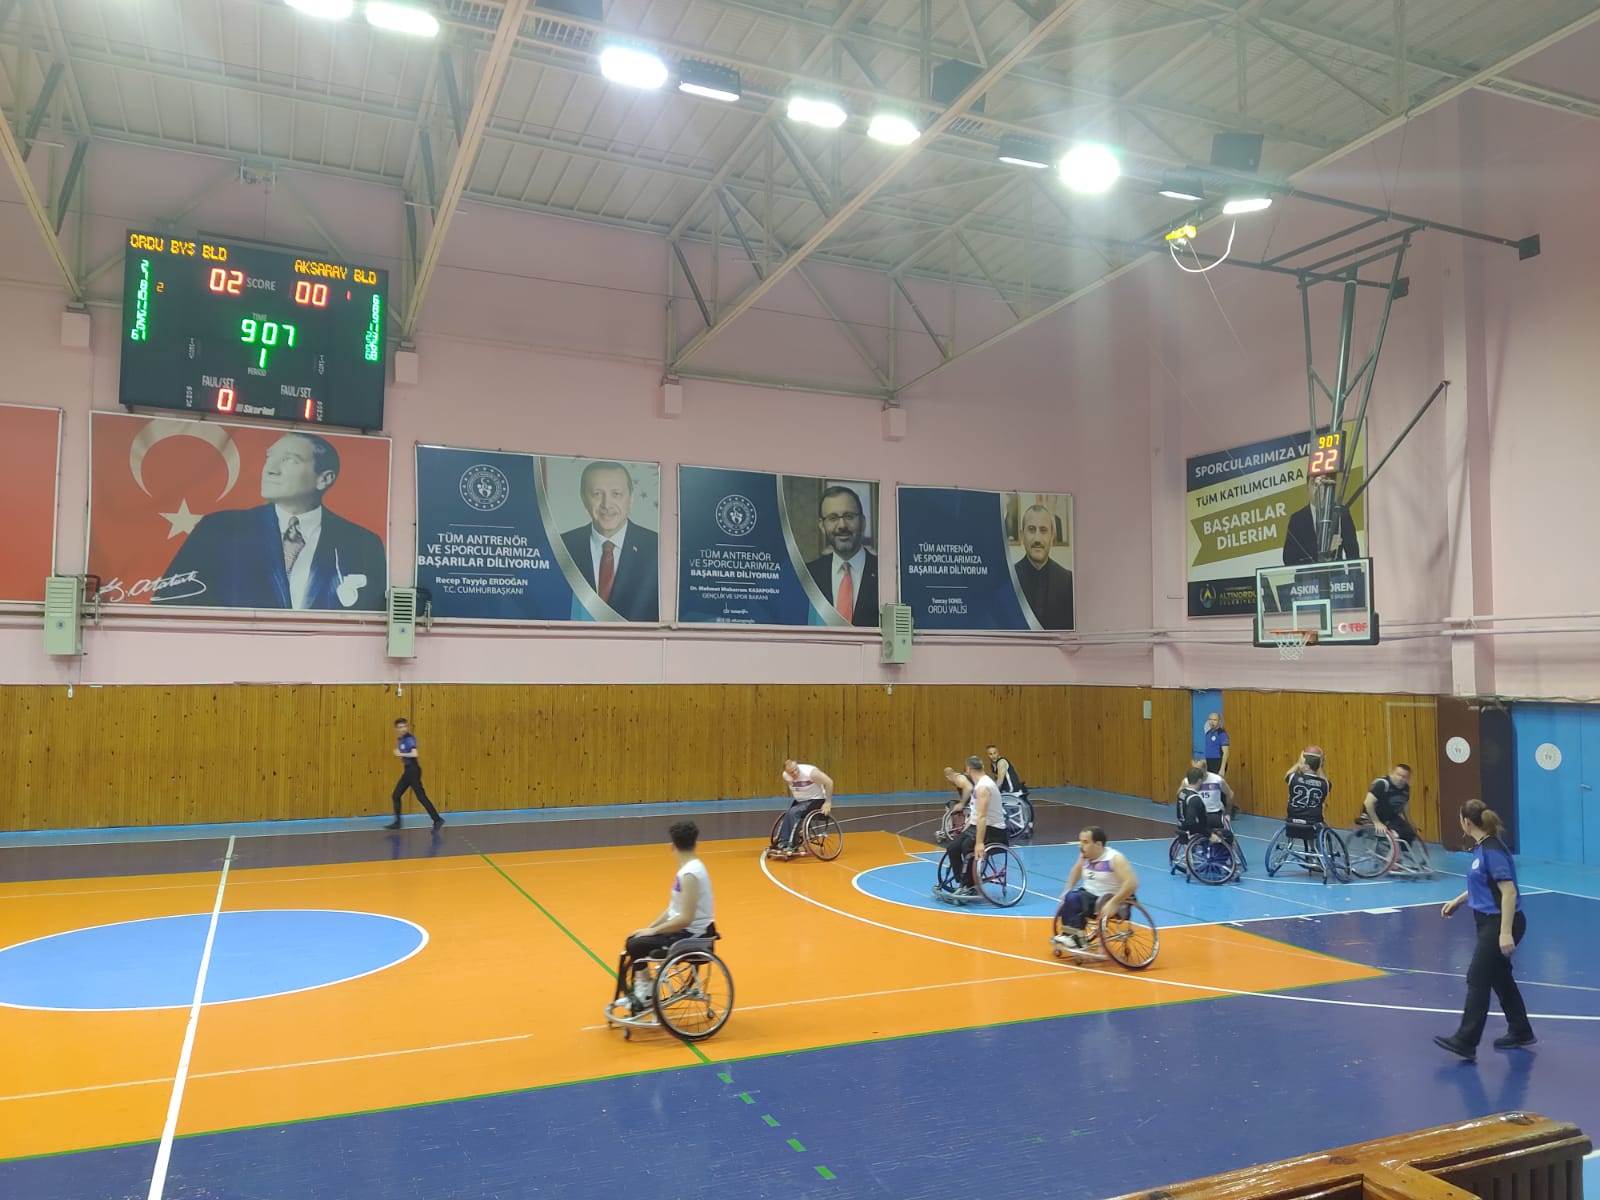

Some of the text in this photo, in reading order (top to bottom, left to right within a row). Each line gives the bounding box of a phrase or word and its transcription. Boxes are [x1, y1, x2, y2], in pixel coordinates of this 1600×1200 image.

[130, 234, 164, 251] ORDU
[202, 244, 228, 260] BLD
[294, 260, 377, 284] AKSARAY BLD
[209, 268, 244, 294] 02
[246, 277, 276, 291] SCORE
[295, 281, 328, 306] 00
[260, 348, 266, 368] 1
[202, 375, 234, 389] FAUL/SET
[280, 384, 312, 398] FAUL/SET
[217, 388, 234, 412] 0
[305, 398, 311, 420] 1
[1194, 446, 1296, 478] SPORCULARIMIZA
[1312, 449, 1338, 472] 22
[1220, 468, 1304, 501] KATILIMCILARA
[1202, 502, 1287, 536] BAŞARILAR
[438, 532, 528, 546] TÜM ANTRENÖR
[427, 544, 540, 558] VE SPORCULARIMIZA
[700, 549, 771, 561] TÜM ANTRENÖR
[918, 542, 973, 554] TÜM ANTRENÖR
[418, 555, 550, 570] BAŞARILAR DİLİYORUM
[690, 559, 780, 571] VE SPORCULARIMIZA
[914, 554, 982, 564] VE SPORCULARIMIZA
[690, 569, 780, 580] BAŞARILAR DİLİYORUM
[908, 566, 988, 576] BAŞARILAR DİLİYORUM
[436, 576, 528, 586] Recep Tayyip ERDOĞAN
[457, 586, 524, 596] CUMHURBAŞKANI
[1290, 584, 1319, 597] AŞKIN
[928, 605, 948, 614] ORDU
[1292, 784, 1322, 808] 26
